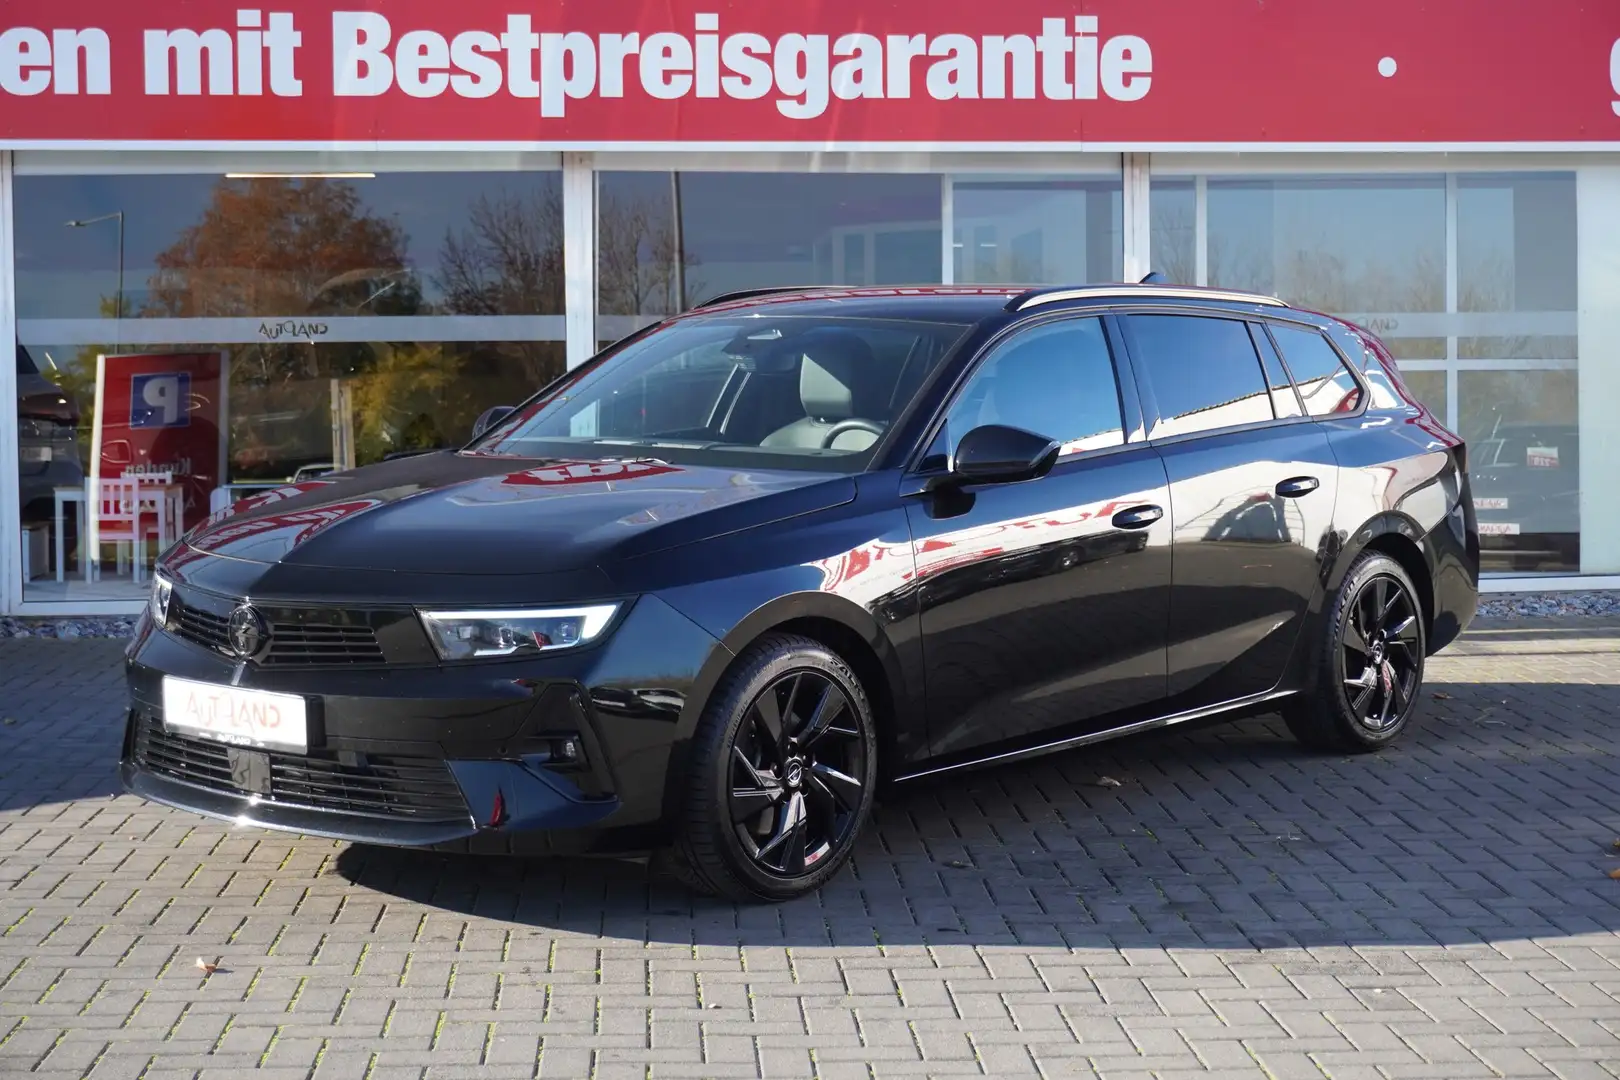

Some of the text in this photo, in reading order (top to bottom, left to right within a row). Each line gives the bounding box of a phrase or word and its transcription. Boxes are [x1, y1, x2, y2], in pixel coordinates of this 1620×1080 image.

[0, 10, 1153, 119] en mit Bestpreisgarantie
[258, 320, 328, 340] AUTOLAND
